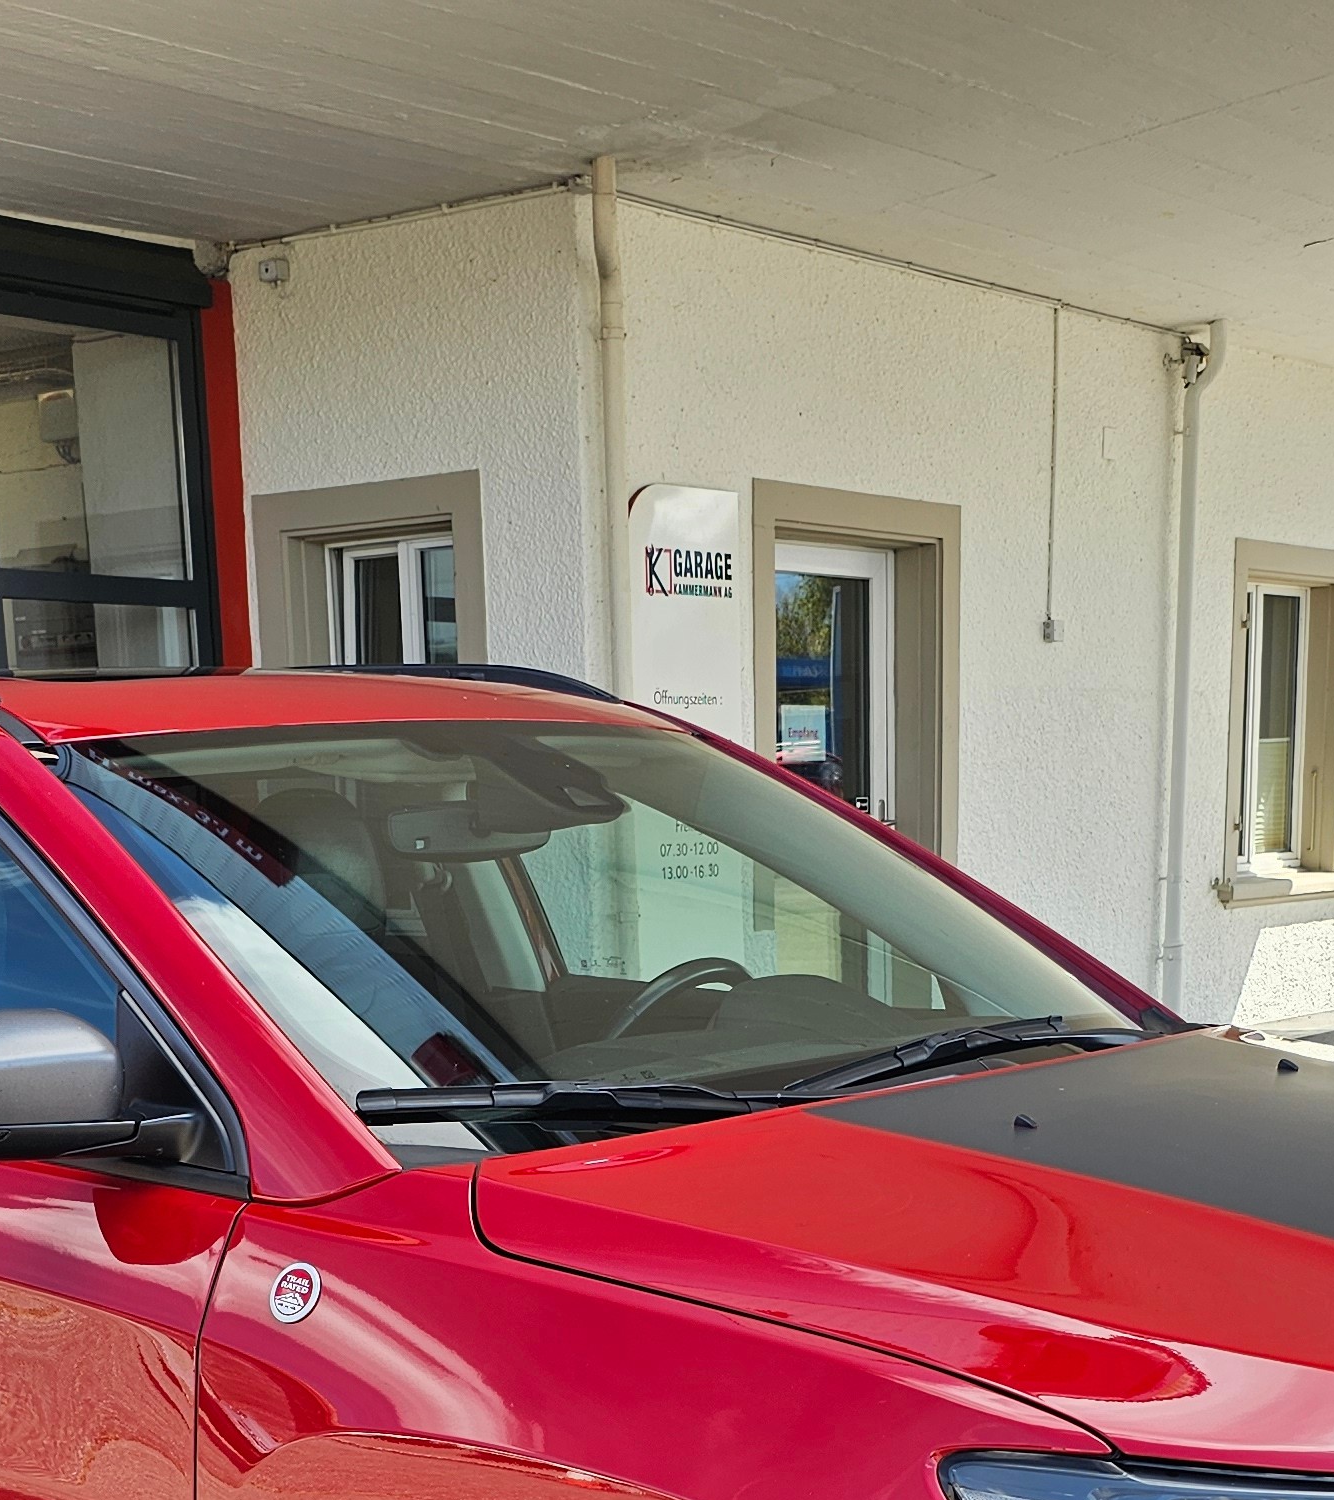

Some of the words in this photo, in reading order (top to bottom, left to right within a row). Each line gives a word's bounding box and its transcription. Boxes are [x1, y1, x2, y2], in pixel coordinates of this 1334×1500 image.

[673, 548, 733, 581] GARAGE
[673, 583, 722, 598] KAMMERMANN
[724, 587, 733, 599] AG
[653, 687, 718, 710] Öffnungszeiten
[788, 727, 819, 739] Empfang
[280, 1281, 310, 1294] RATED
[286, 1274, 310, 1287] TRAIL
